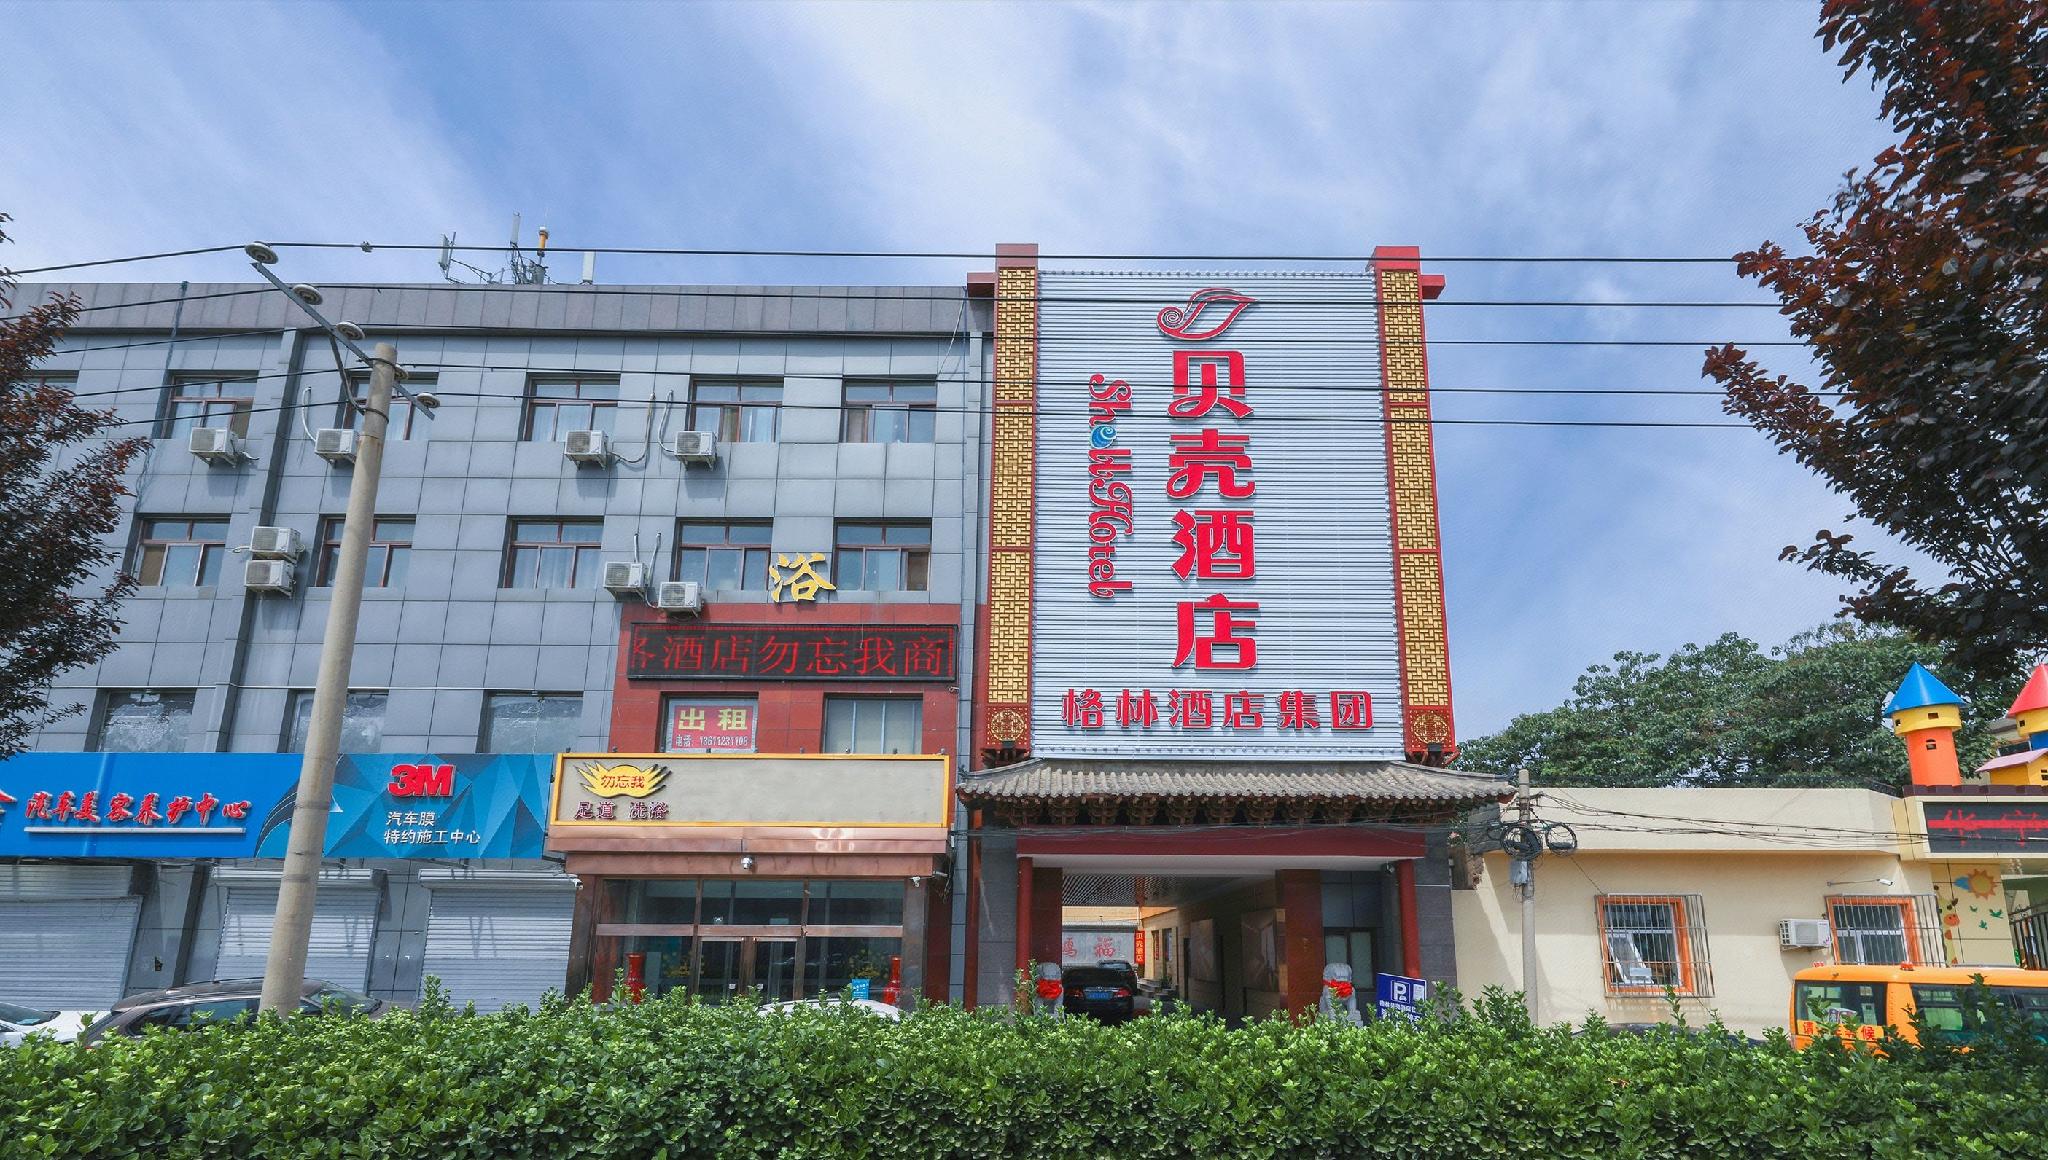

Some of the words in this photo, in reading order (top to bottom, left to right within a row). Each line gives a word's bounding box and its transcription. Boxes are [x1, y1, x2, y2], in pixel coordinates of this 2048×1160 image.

[1165, 349, 1260, 671] 贝壳酒店
[769, 553, 837, 603] 浴
[678, 707, 748, 731] 出租
[1061, 688, 1374, 731] 格林酒店集团
[388, 764, 456, 797] 3M
[601, 775, 645, 789] 勿忘我
[25, 790, 252, 826] 汽车美容养护中心
[386, 811, 436, 827] 汽车膜
[575, 801, 617, 820] 足道
[629, 801, 670, 820] 洗浴
[384, 828, 480, 845] 特约施工中心
